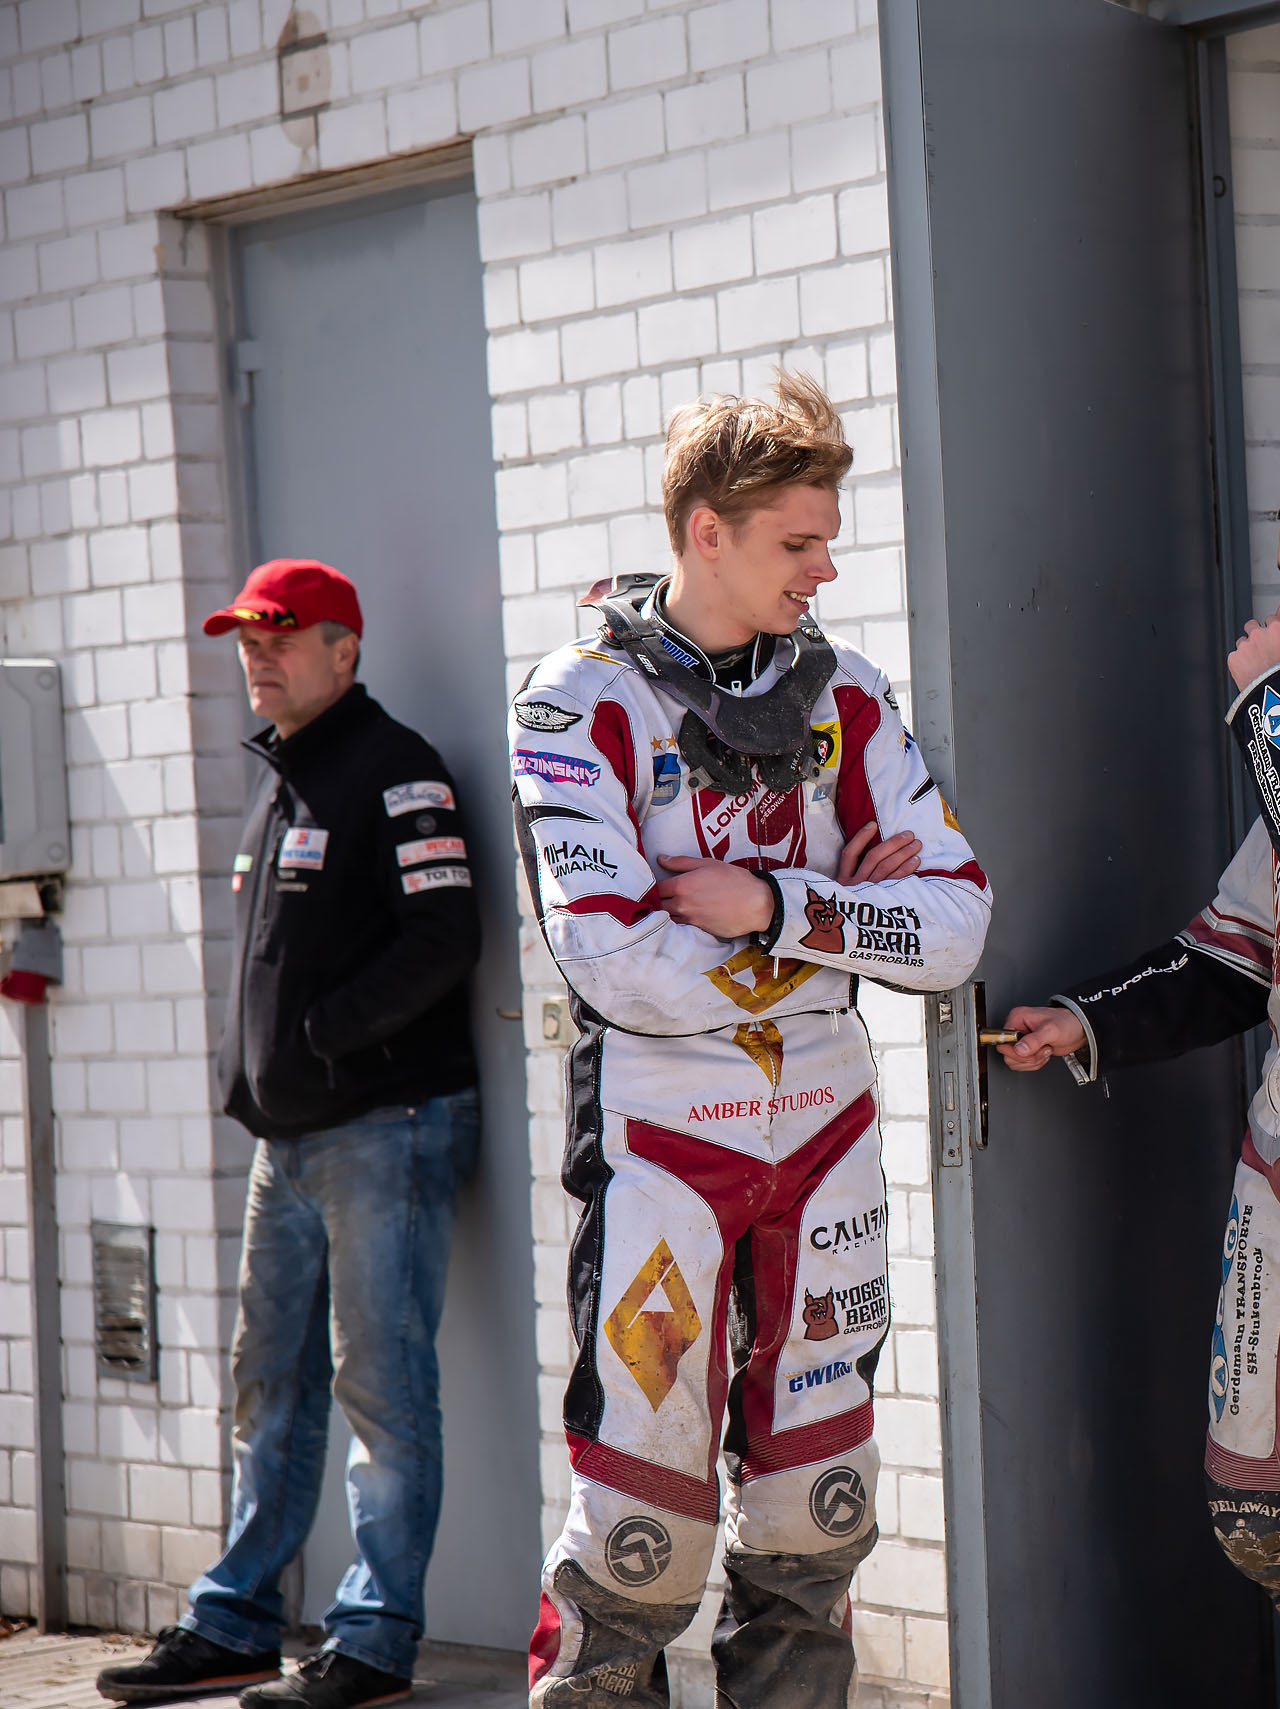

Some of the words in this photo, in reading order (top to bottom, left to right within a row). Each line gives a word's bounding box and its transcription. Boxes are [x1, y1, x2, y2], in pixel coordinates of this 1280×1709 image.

[1249, 705, 1271, 771] Gerdemann
[838, 901, 921, 931] YOGGY
[848, 950, 925, 967] GASTROBARS
[856, 926, 921, 955] BEAR
[687, 1100, 761, 1123] AMBER
[767, 1086, 835, 1115] STUDIOS
[1236, 1204, 1253, 1319] TRANSPORTE
[835, 1274, 886, 1310] YOGGY
[845, 1297, 886, 1327] BEAR
[1247, 1247, 1263, 1376] SH-Stukenbrock
[1230, 1323, 1245, 1416] Gerdemann
